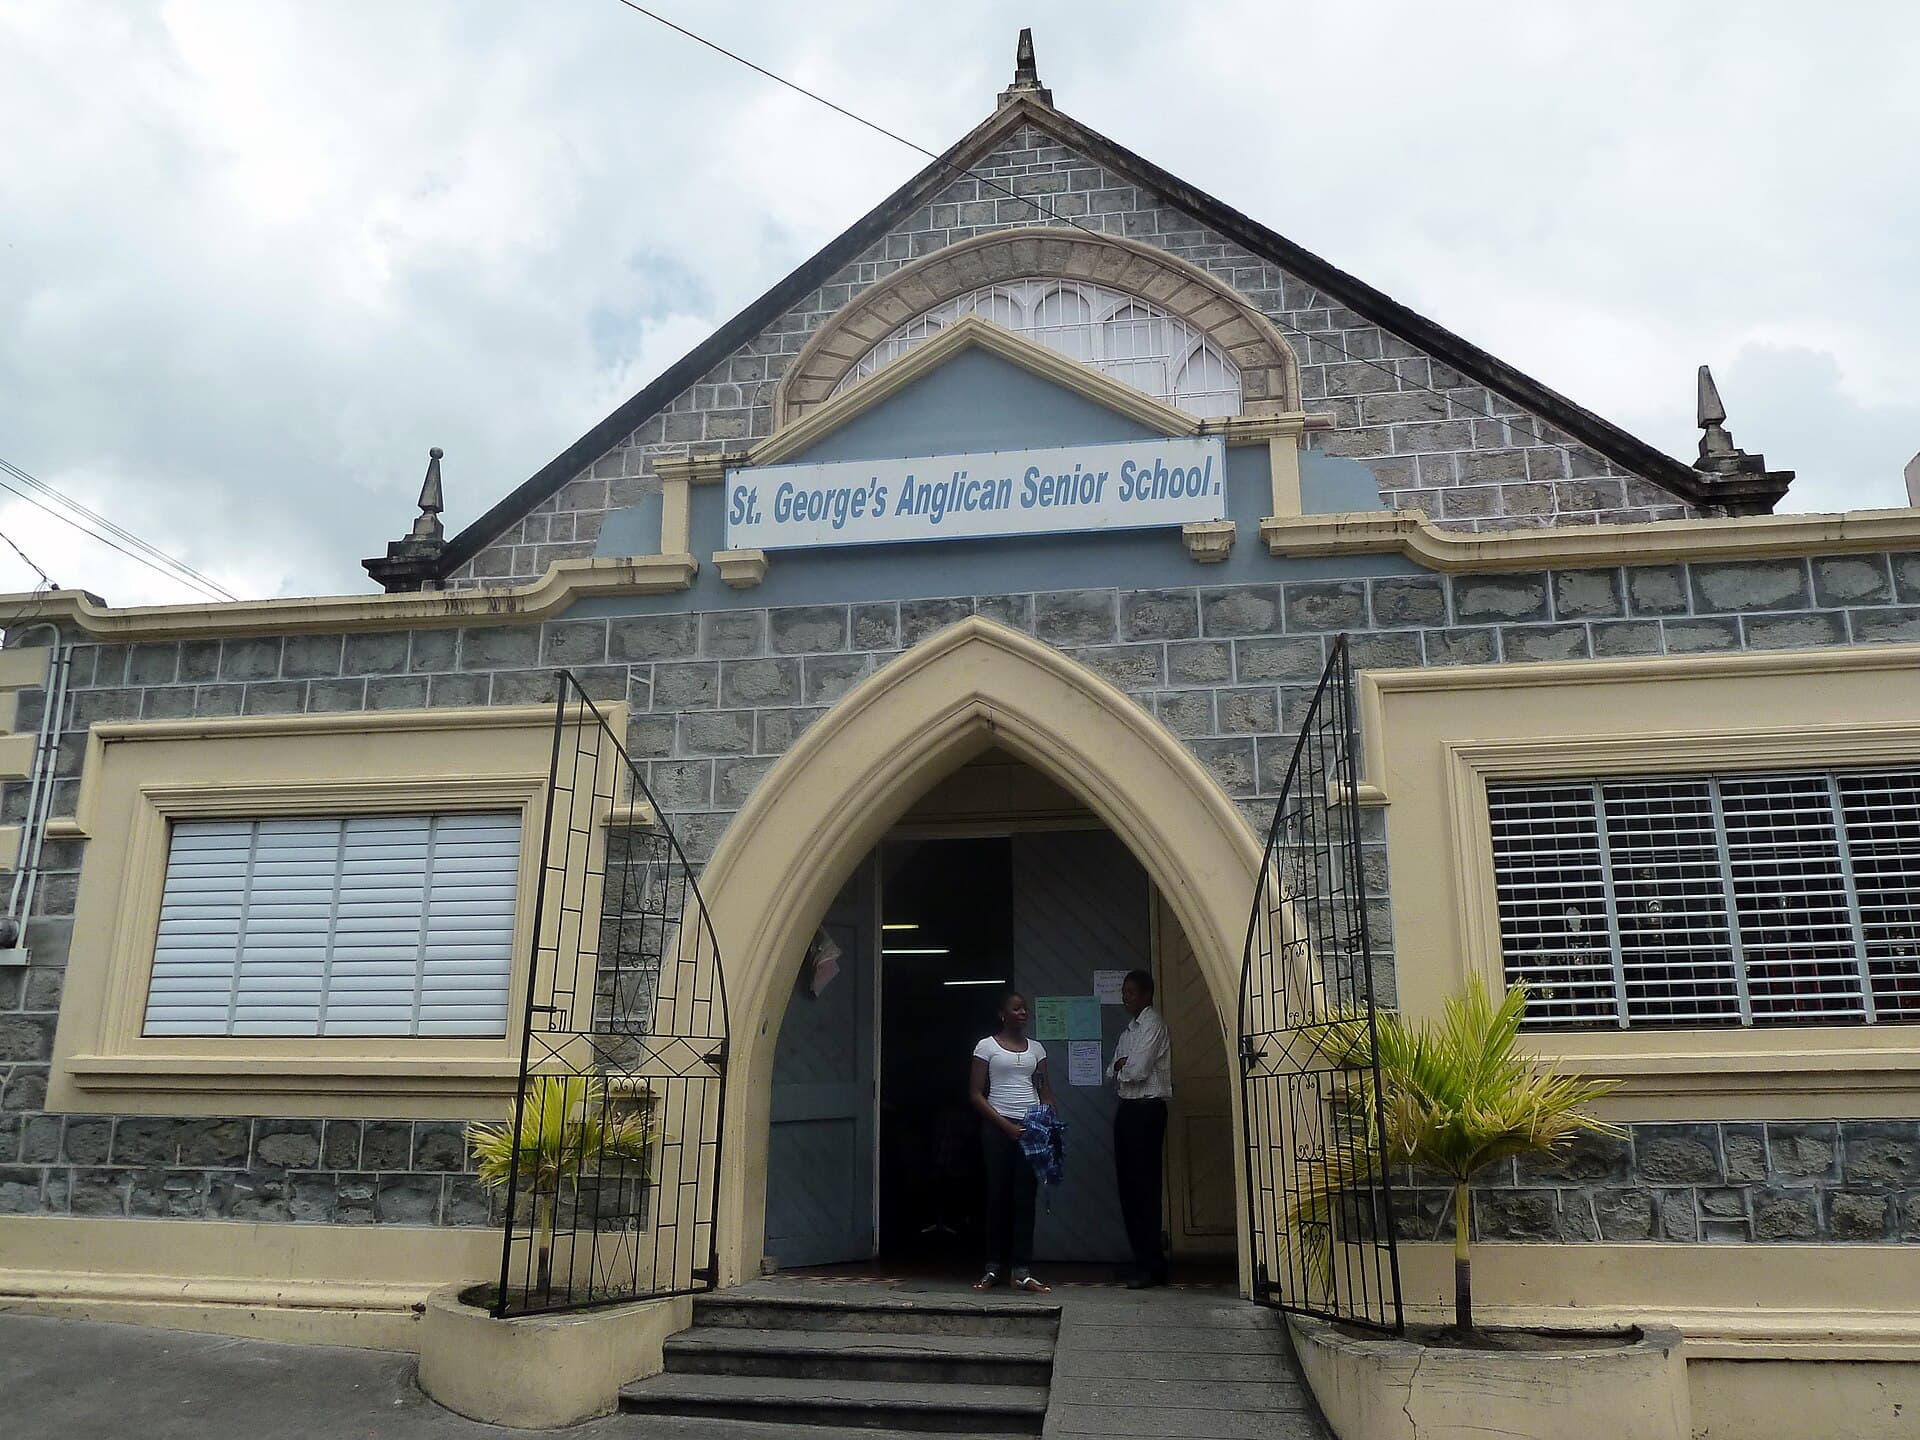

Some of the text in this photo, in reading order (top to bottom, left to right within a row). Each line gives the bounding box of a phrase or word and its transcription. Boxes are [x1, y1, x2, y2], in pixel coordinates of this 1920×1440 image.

[729, 456, 1221, 529] St. George's Anglican Senior School.
